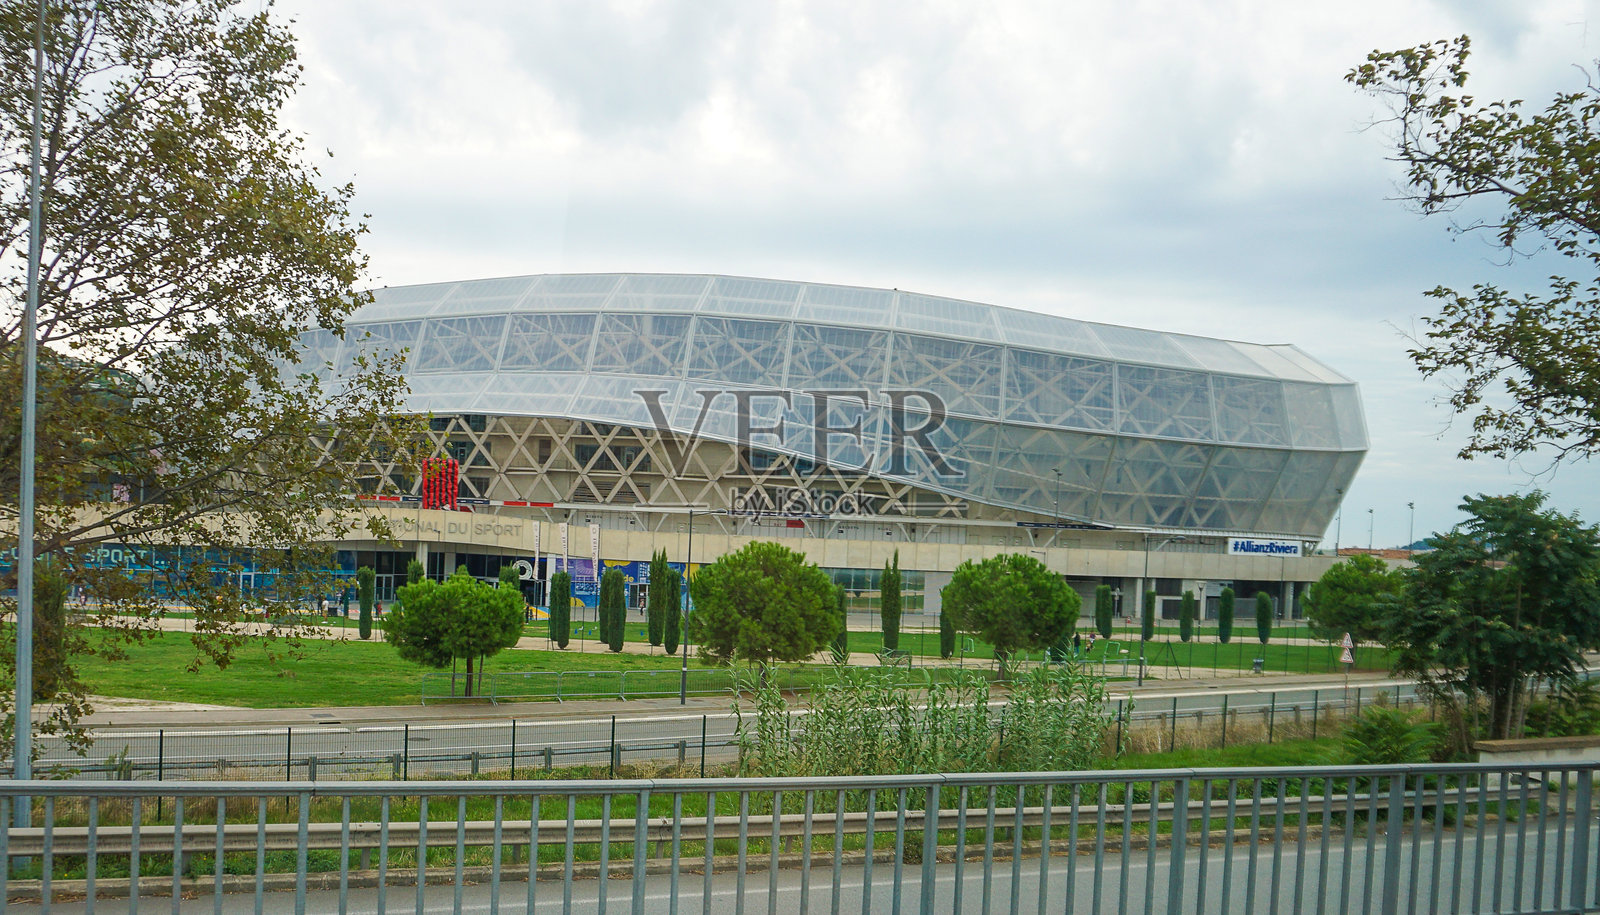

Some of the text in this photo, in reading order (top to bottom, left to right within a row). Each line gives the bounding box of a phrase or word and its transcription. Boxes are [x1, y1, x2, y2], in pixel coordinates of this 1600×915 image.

[447, 521, 468, 535] DU
[474, 522, 523, 537] SPORT
[1232, 540, 1298, 554] #AllianzRiviera
